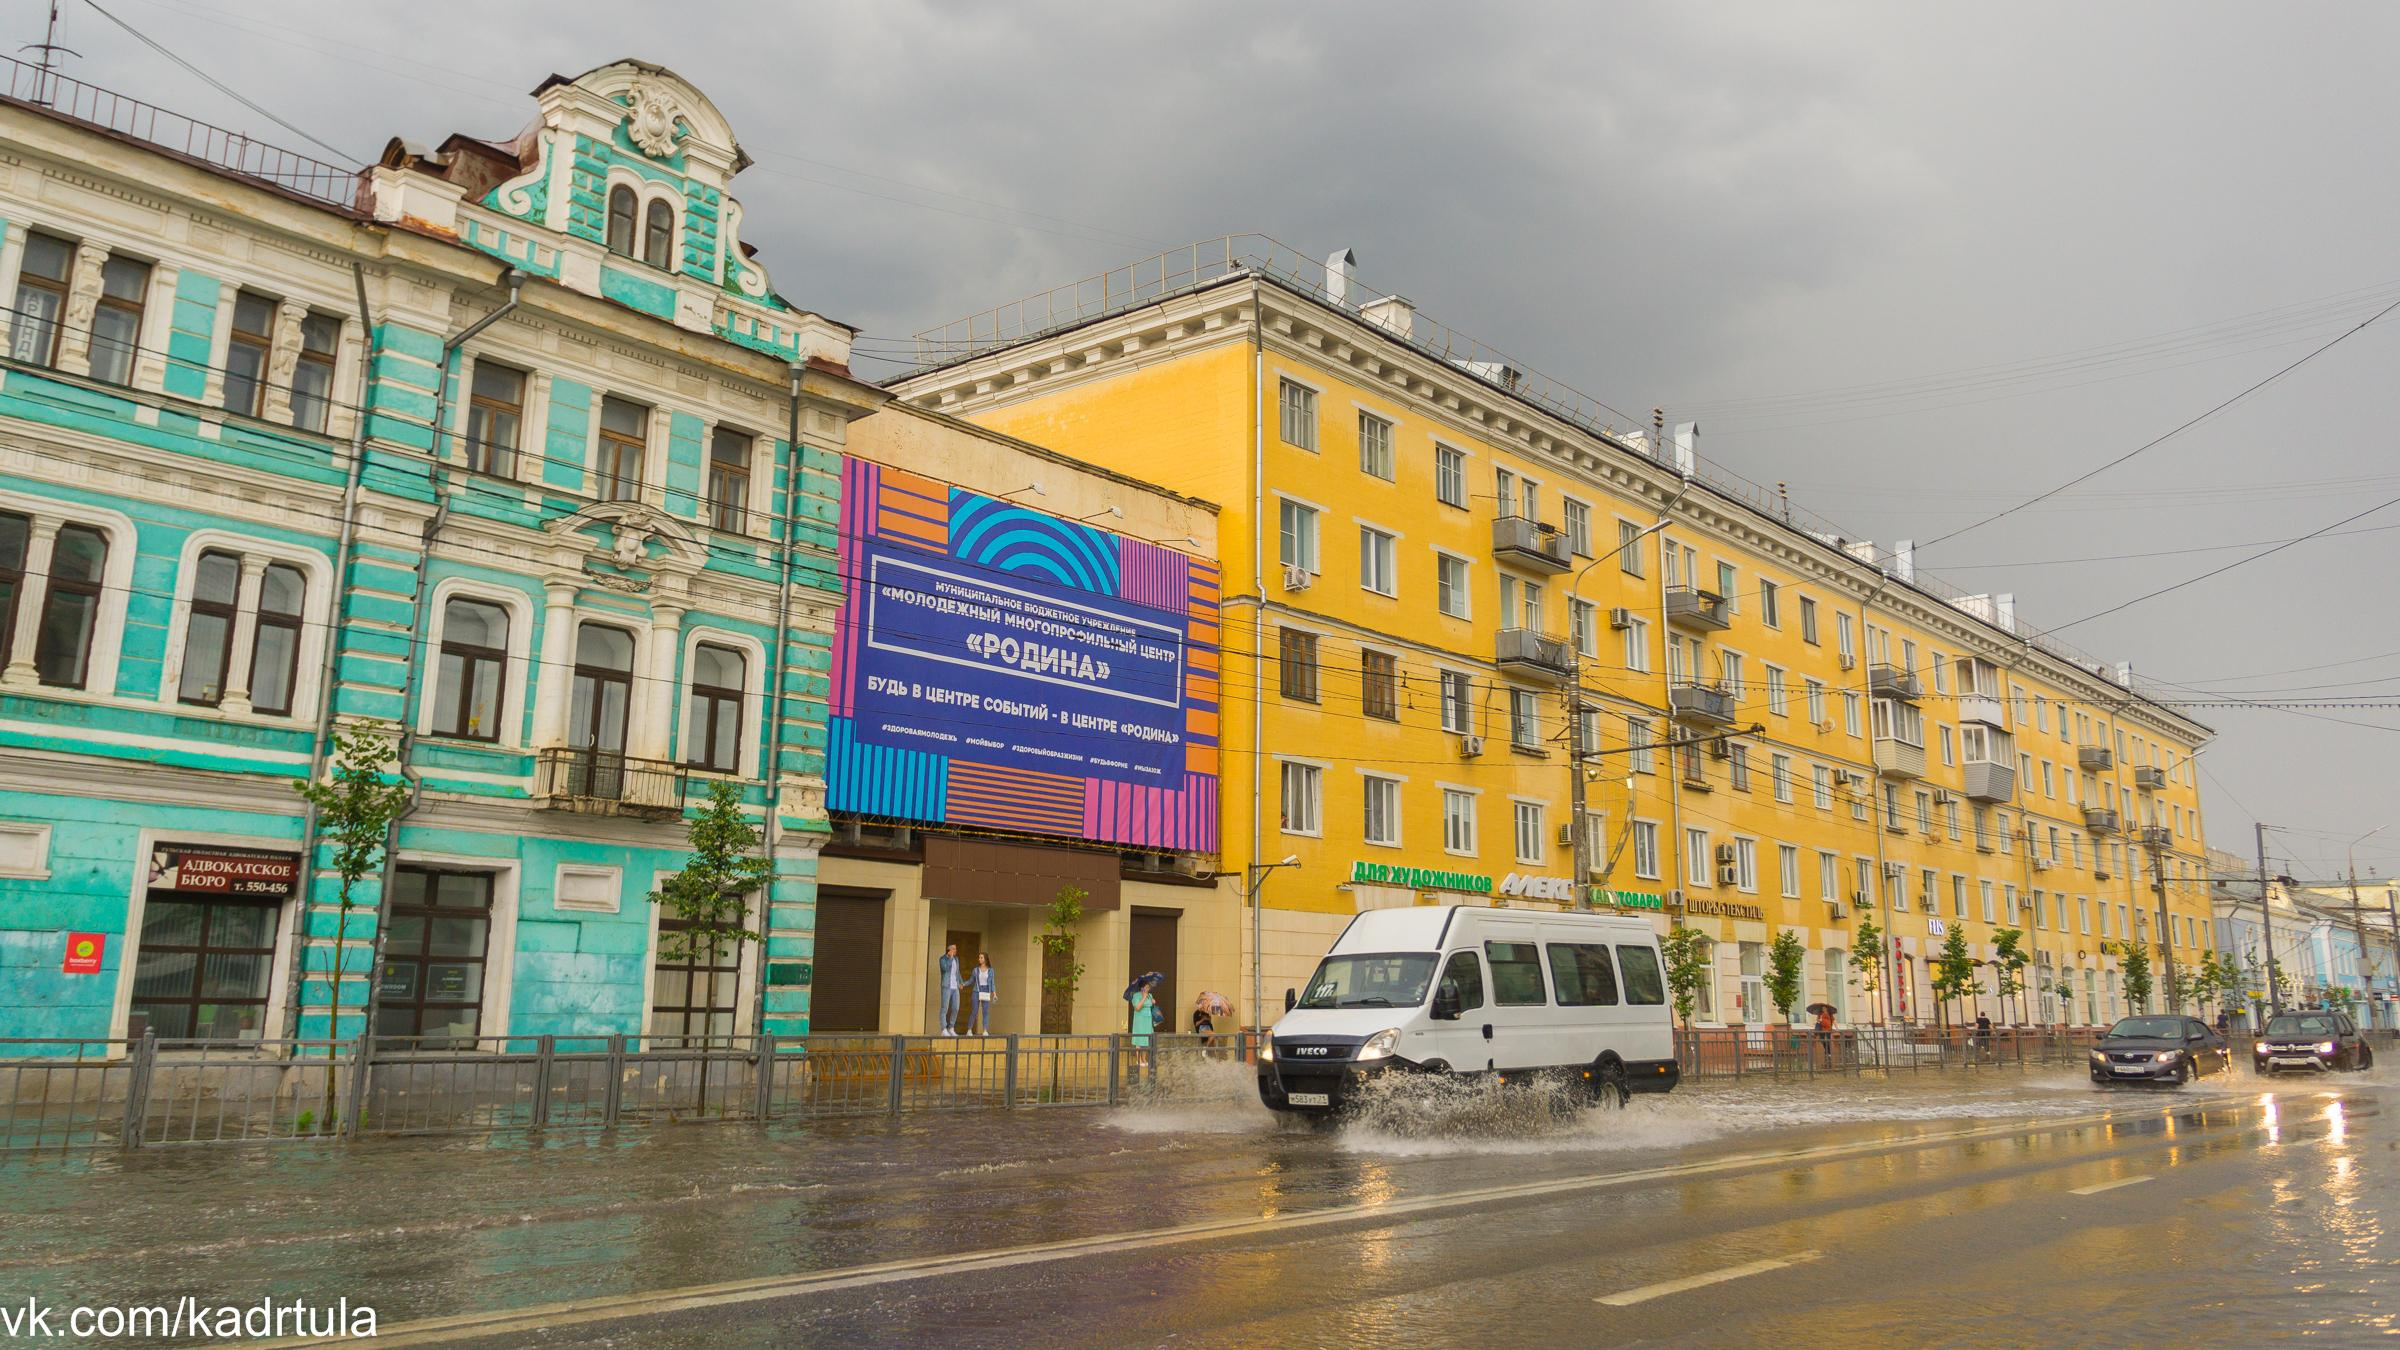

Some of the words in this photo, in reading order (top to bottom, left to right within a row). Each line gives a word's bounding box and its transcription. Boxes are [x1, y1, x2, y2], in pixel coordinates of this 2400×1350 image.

[935, 581, 1022, 609] МУНИЦИПАЛЬНОЕ
[1024, 602, 1080, 624] БЮДЖЕТНОЕ
[1004, 613, 1137, 655] МНОГОПРОФИЛЬНЫЙ
[1140, 644, 1176, 663] ЦЕНТР
[965, 632, 1111, 681] «РОДИНА»
[867, 675, 908, 697] БУДЬ
[912, 683, 922, 698] В
[925, 686, 980, 709] ЦЕНТРЕ
[983, 696, 1049, 721] СОБЫТИЙ
[1060, 710, 1068, 724] В
[1071, 712, 1118, 734] ЦЕНТРЕ
[1120, 723, 1180, 744] «РОДИНА»
[965, 736, 1005, 750] #МОЙВЫБОР
[183, 859, 291, 877] АДВОКАТСКОЕ
[1354, 861, 1389, 882] ДЛЯ
[1390, 865, 1493, 893] ХУДОЖНИКОВ
[181, 873, 226, 887] БЮРО
[245, 881, 289, 893] 550-456
[1499, 872, 1575, 901] АЛЕКС
[1590, 887, 1663, 909] КАНТОВАРЫ
[1688, 898, 1721, 914] ШТОРЫ
[1295, 1047, 1328, 1056] IVECO
